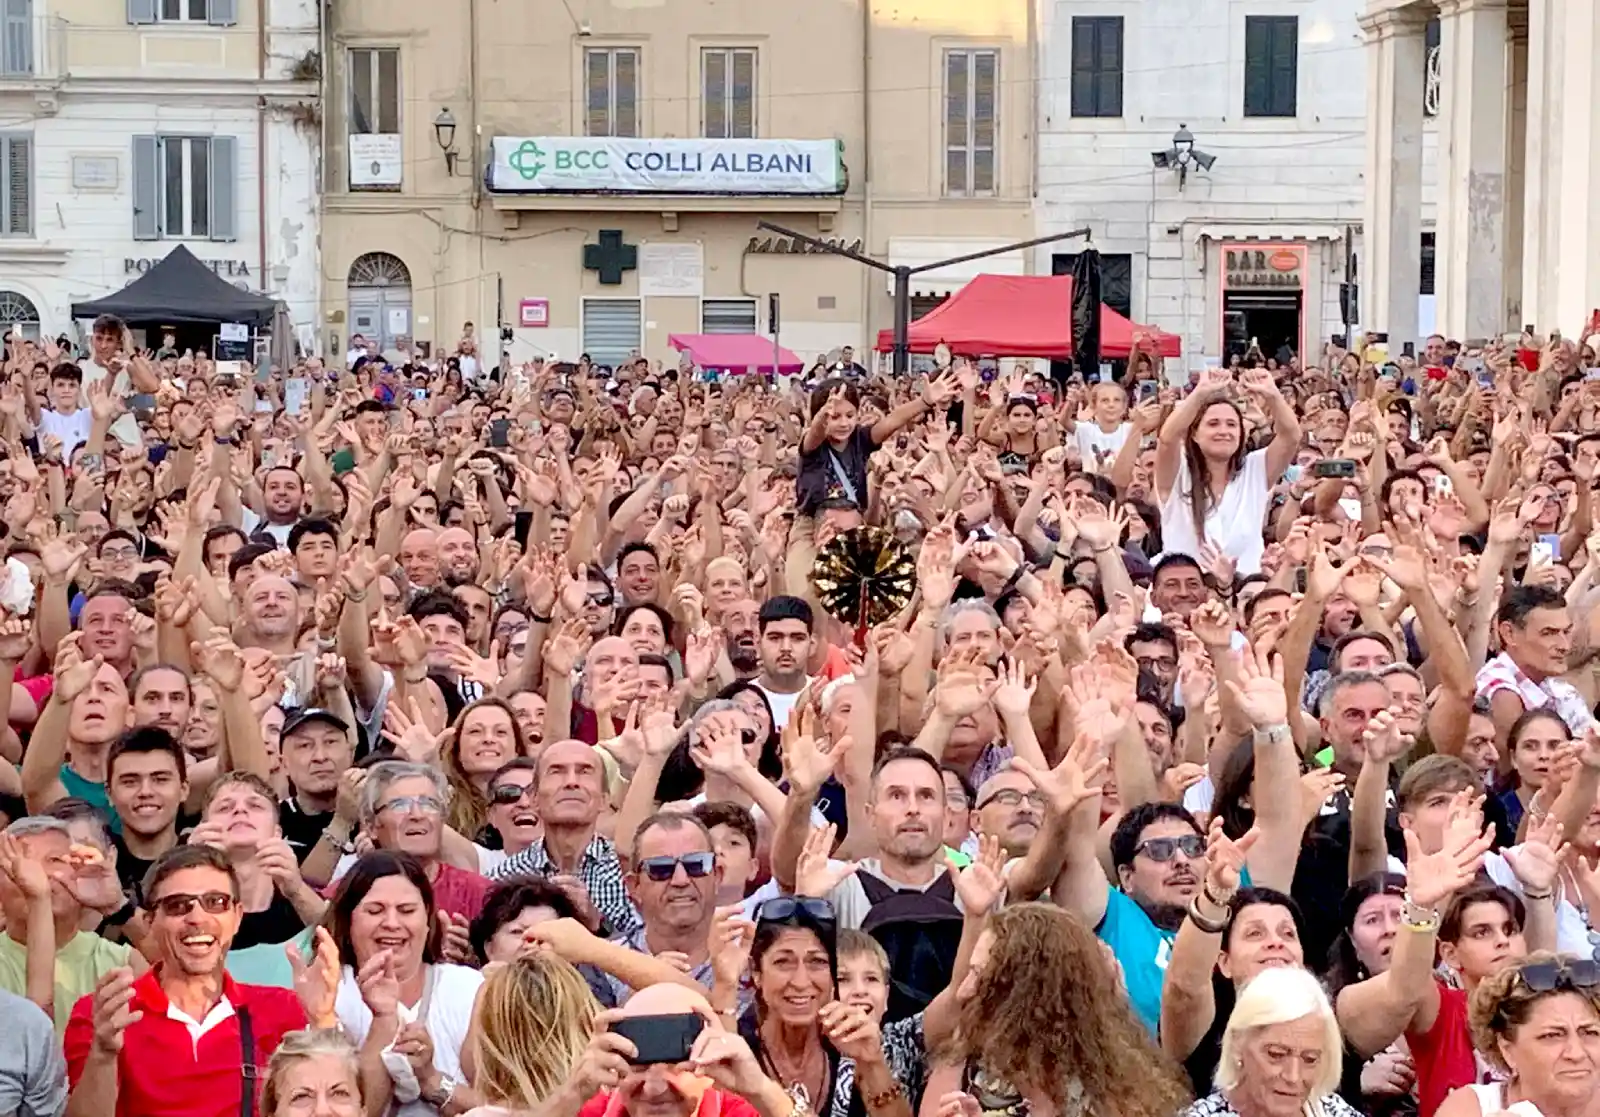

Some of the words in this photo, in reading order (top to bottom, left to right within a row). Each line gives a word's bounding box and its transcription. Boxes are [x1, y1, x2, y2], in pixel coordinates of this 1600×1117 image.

[555, 150, 609, 169] BCC
[625, 152, 701, 171] COLLI
[710, 153, 811, 173] ALBANI
[1226, 251, 1267, 271] BAR
